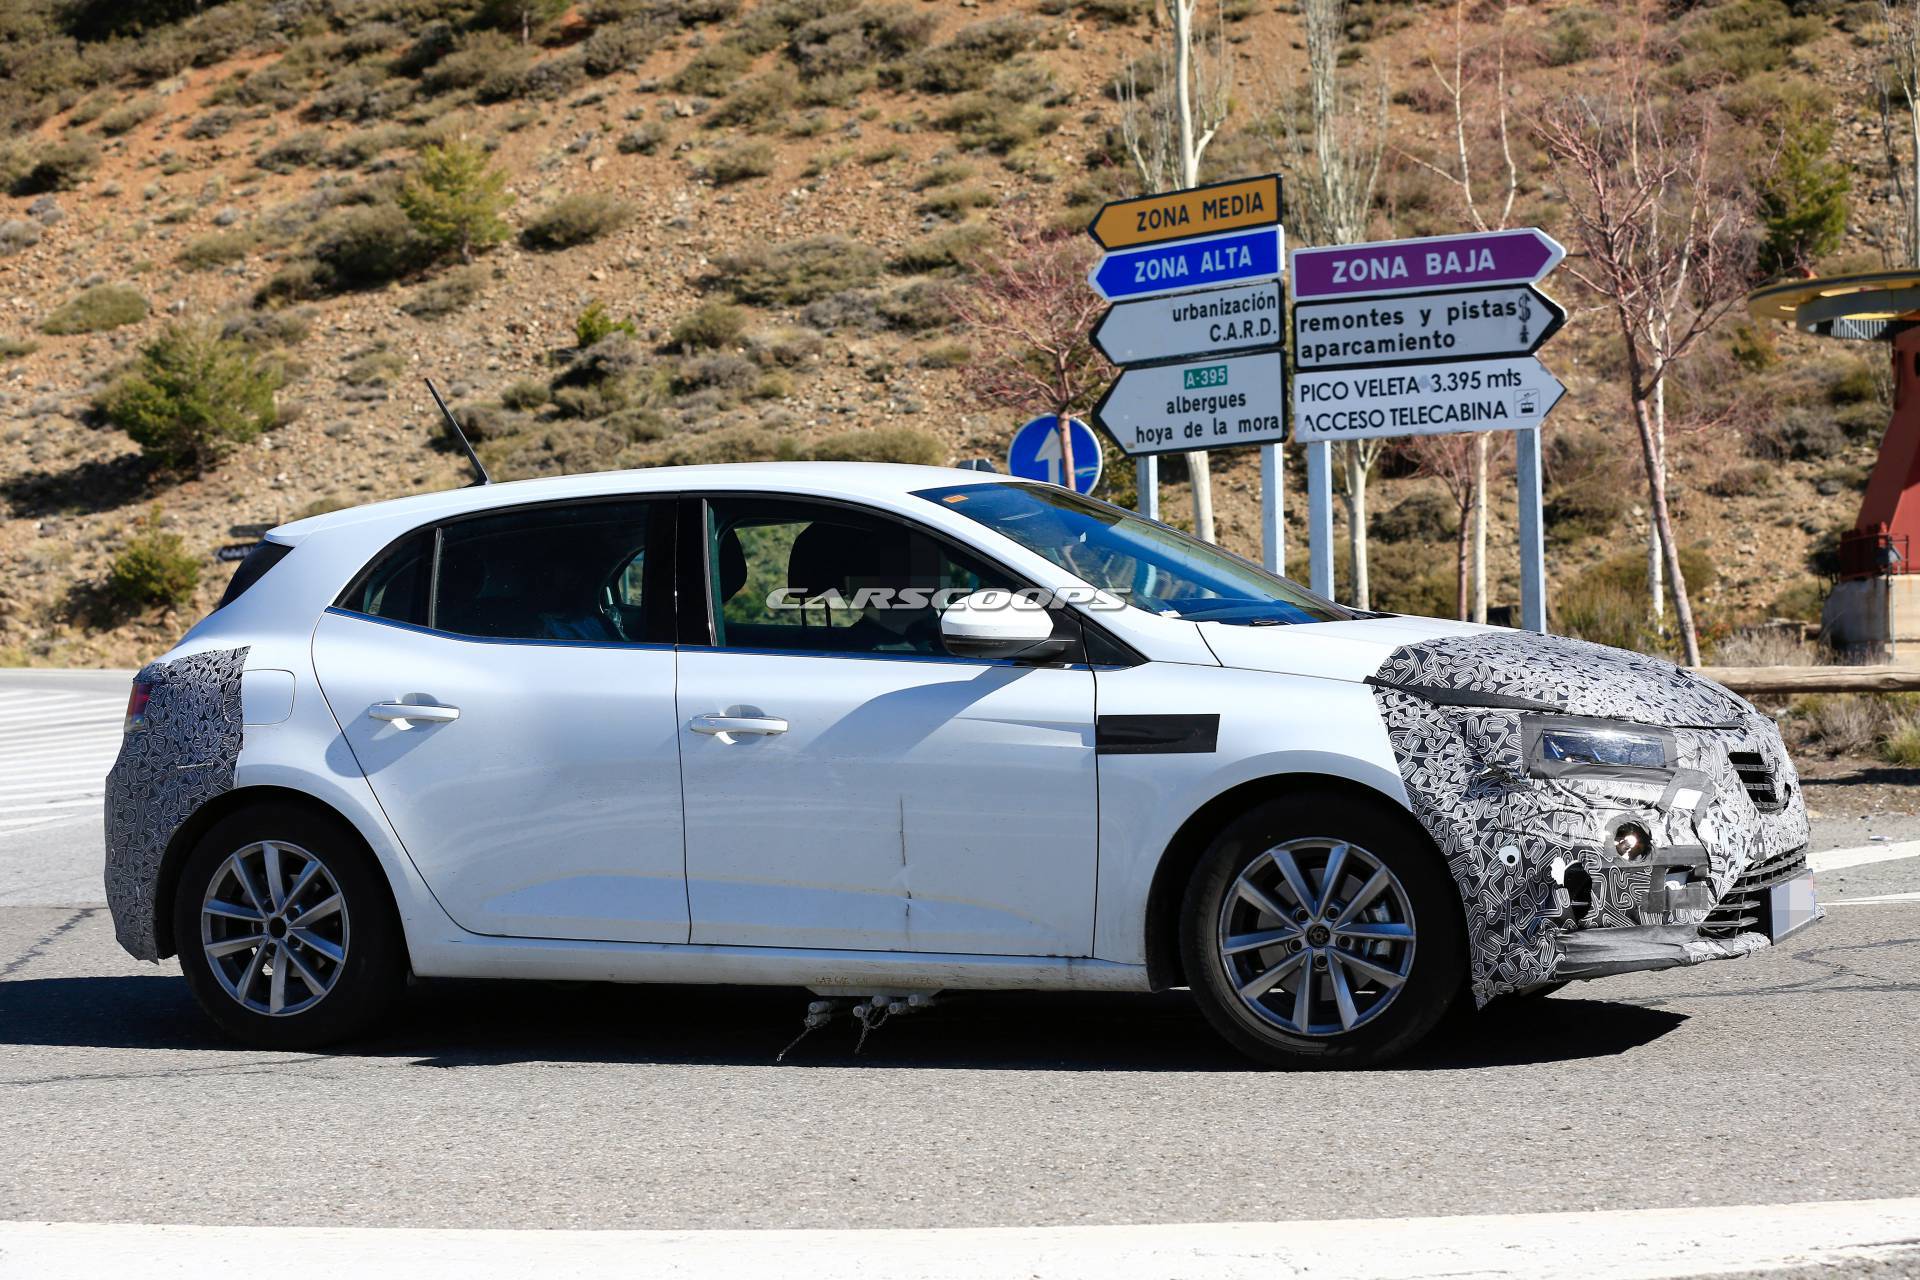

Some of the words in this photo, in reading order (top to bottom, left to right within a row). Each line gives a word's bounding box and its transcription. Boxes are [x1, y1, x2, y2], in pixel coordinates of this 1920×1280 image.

[1136, 204, 1190, 232] ZONA
[1203, 191, 1264, 221] MEDIA
[1134, 255, 1189, 283] ZONA
[1200, 245, 1252, 273] ALTA
[1331, 255, 1409, 284] ZONA
[1425, 248, 1496, 276] BAJA
[1172, 291, 1276, 322] urbanización
[1300, 308, 1404, 332] remontes
[1419, 308, 1432, 327] y
[1447, 298, 1517, 325] pistas
[1209, 318, 1277, 342] C.A.R.D.
[1301, 330, 1456, 362] aparcamiento
[1185, 367, 1227, 387] A-395
[1300, 380, 1349, 402] PICO
[1354, 375, 1420, 398] VELETA
[1430, 370, 1481, 393] 3.395
[1487, 367, 1522, 389] mts
[1166, 392, 1246, 415] albergues
[1389, 400, 1508, 427] TELECABINA
[1136, 425, 1173, 445] hoya
[1184, 421, 1203, 438] de
[1213, 417, 1228, 435] la
[1238, 415, 1279, 433] mora
